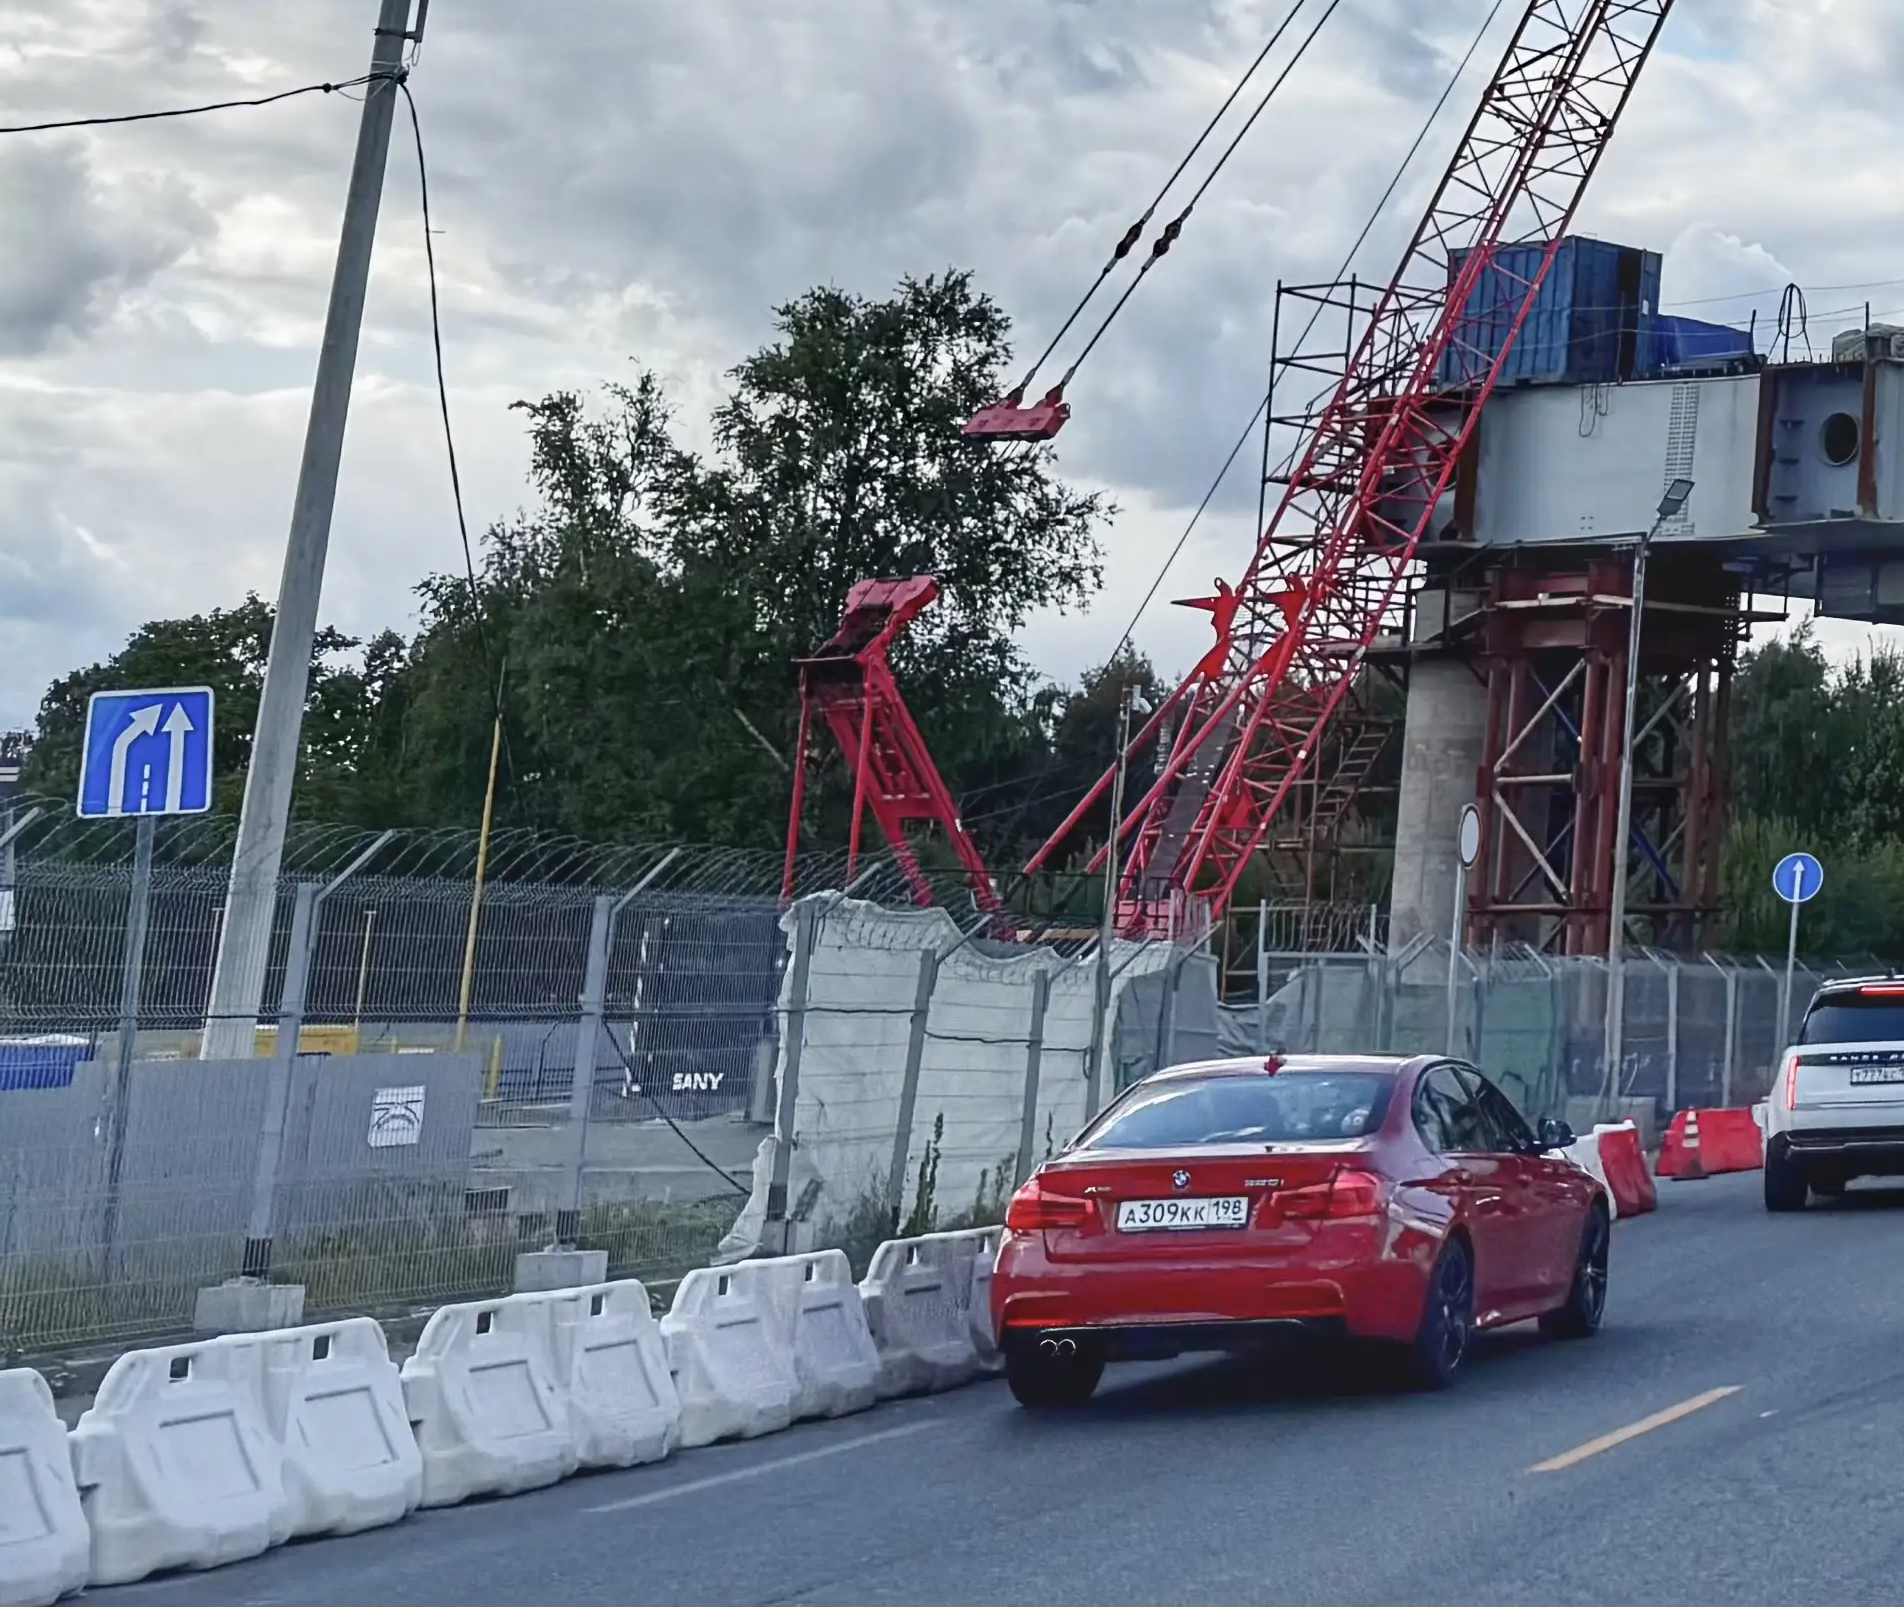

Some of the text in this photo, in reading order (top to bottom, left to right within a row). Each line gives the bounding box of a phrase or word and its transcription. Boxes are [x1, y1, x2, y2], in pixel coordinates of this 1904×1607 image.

[672, 1072, 725, 1091] SANY
[1125, 1199, 1242, 1225] А309КК 198
